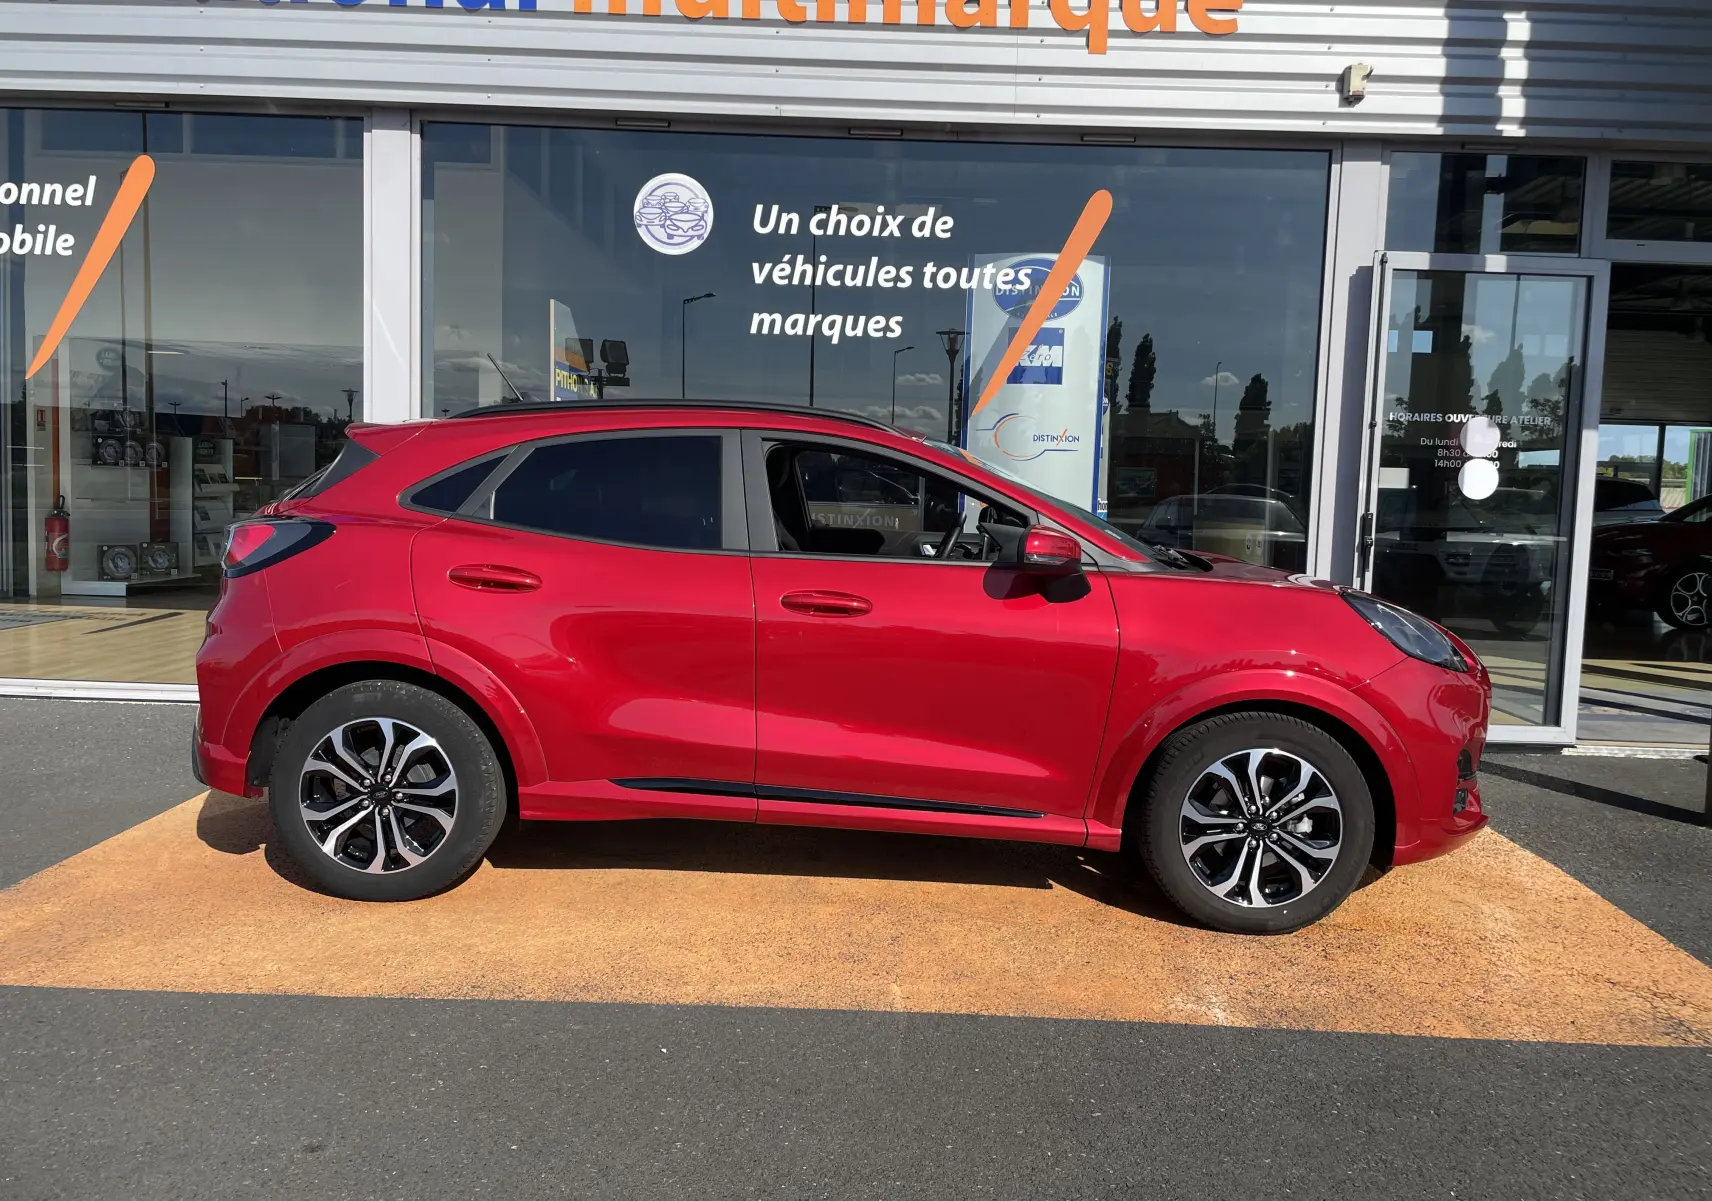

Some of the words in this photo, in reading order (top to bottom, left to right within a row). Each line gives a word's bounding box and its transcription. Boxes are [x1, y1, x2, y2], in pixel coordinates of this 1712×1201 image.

[0, 174, 98, 207] onnel
[753, 204, 800, 236] Un
[809, 204, 905, 238] choix
[911, 206, 954, 239] de
[752, 254, 914, 289] véhicules
[923, 261, 1032, 292] toutes
[750, 312, 903, 345] marques
[1388, 411, 1443, 423] HORAIRES
[1444, 413, 1508, 425] OUVURE
[1509, 415, 1552, 426] ATELIER
[1420, 437, 1433, 446] Du
[1435, 437, 1459, 447] lundi
[1437, 448, 1461, 458] 8h30
[1434, 459, 1462, 469] 14h00
